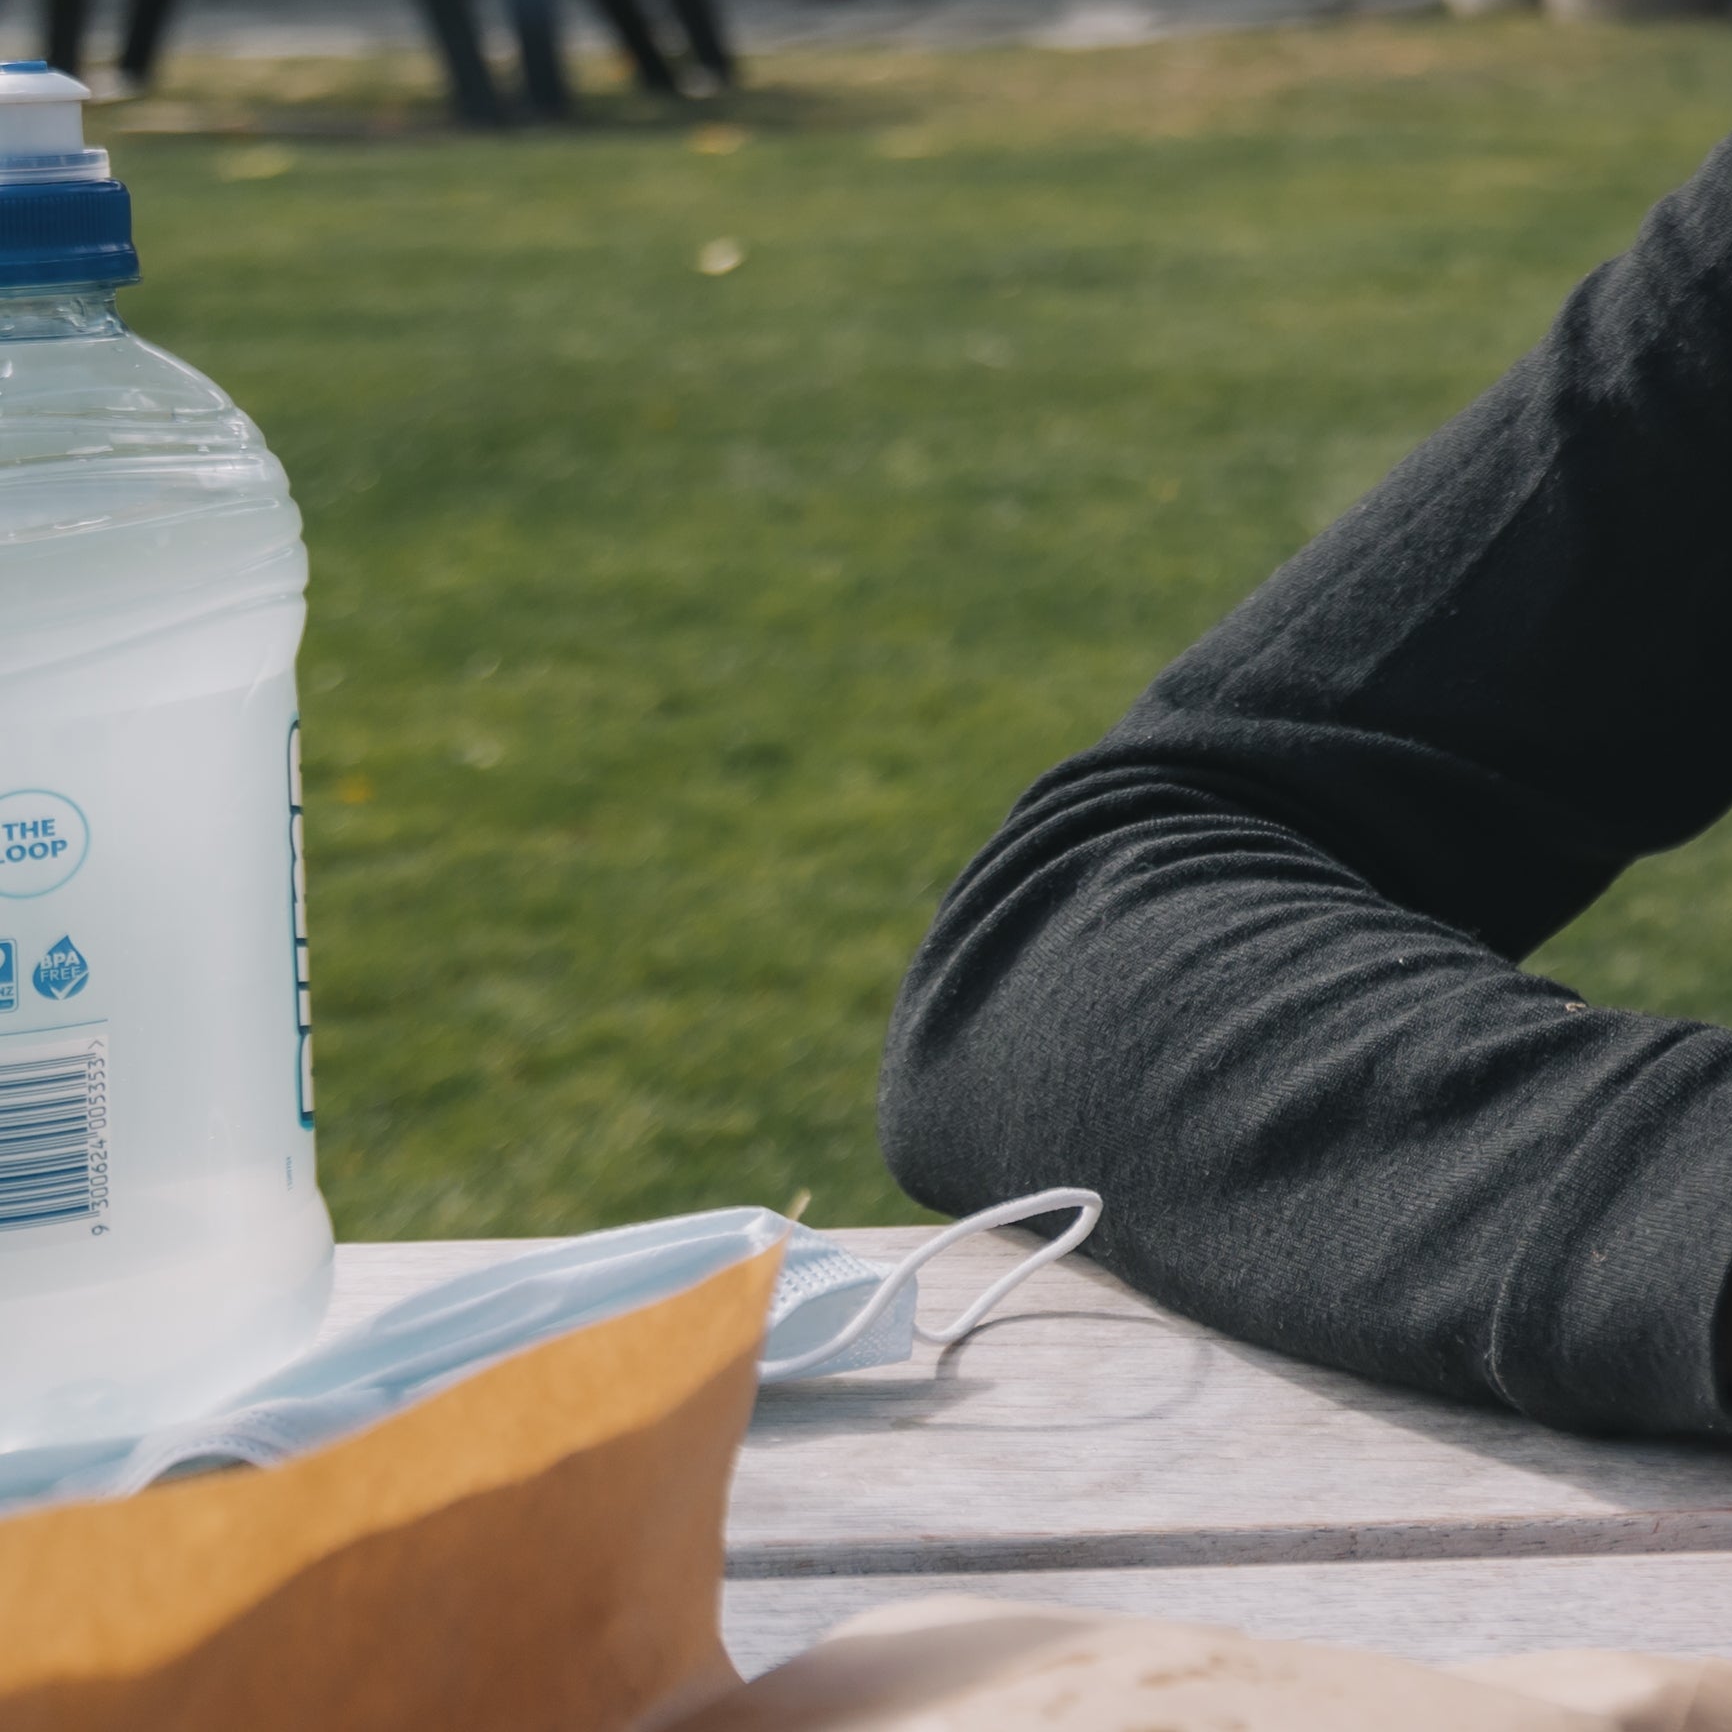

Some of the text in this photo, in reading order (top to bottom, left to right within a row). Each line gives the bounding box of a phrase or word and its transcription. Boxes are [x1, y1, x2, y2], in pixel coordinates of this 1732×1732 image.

[2, 818, 56, 841] THE
[41, 950, 80, 968] BPA
[40, 966, 81, 983] FREE
[88, 1058, 109, 1236] 9 300624 005353
